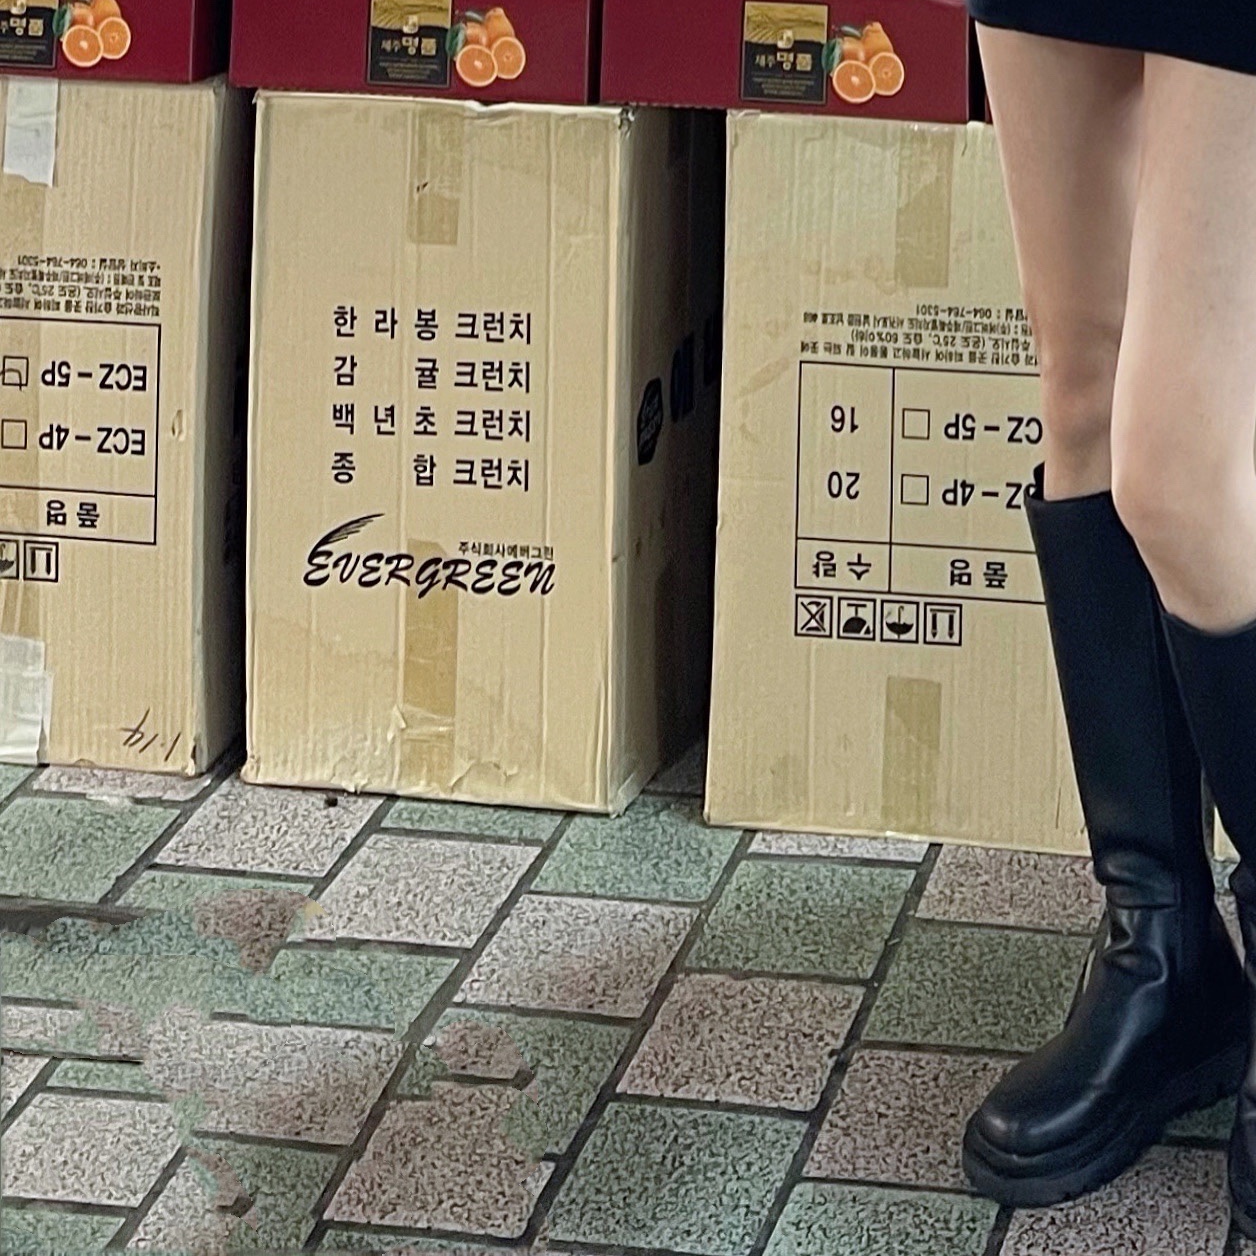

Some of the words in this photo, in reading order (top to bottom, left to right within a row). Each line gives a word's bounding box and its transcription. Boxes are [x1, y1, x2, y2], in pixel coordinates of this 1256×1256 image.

[454, 311, 532, 345] 크런치
[453, 360, 531, 394] 크런치
[453, 409, 531, 443] 크런치
[830, 405, 859, 434] 16
[943, 412, 1044, 446] CZ-5P
[452, 458, 530, 492] 크런치
[827, 471, 861, 500] 20
[46, 498, 100, 529] 품명
[303, 544, 556, 599] EVERGREEN
[812, 550, 872, 580] 수량
[950, 558, 1009, 589] 품명
